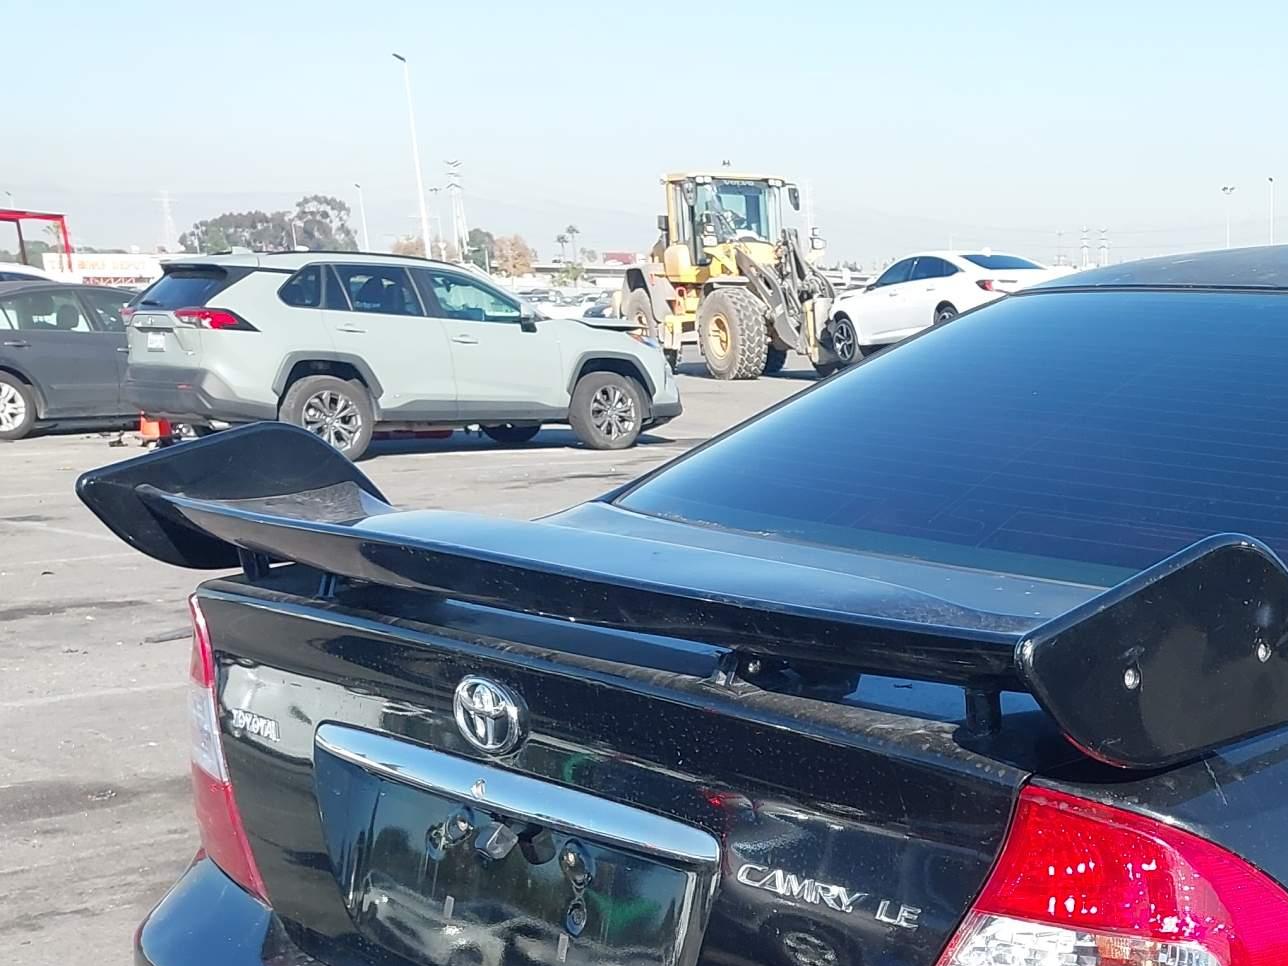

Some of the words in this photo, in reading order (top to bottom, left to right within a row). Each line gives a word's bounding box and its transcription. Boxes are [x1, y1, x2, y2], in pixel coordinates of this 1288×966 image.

[231, 708, 280, 741] TOYOTA
[737, 863, 869, 913] CAMRY
[874, 899, 922, 930] LE
